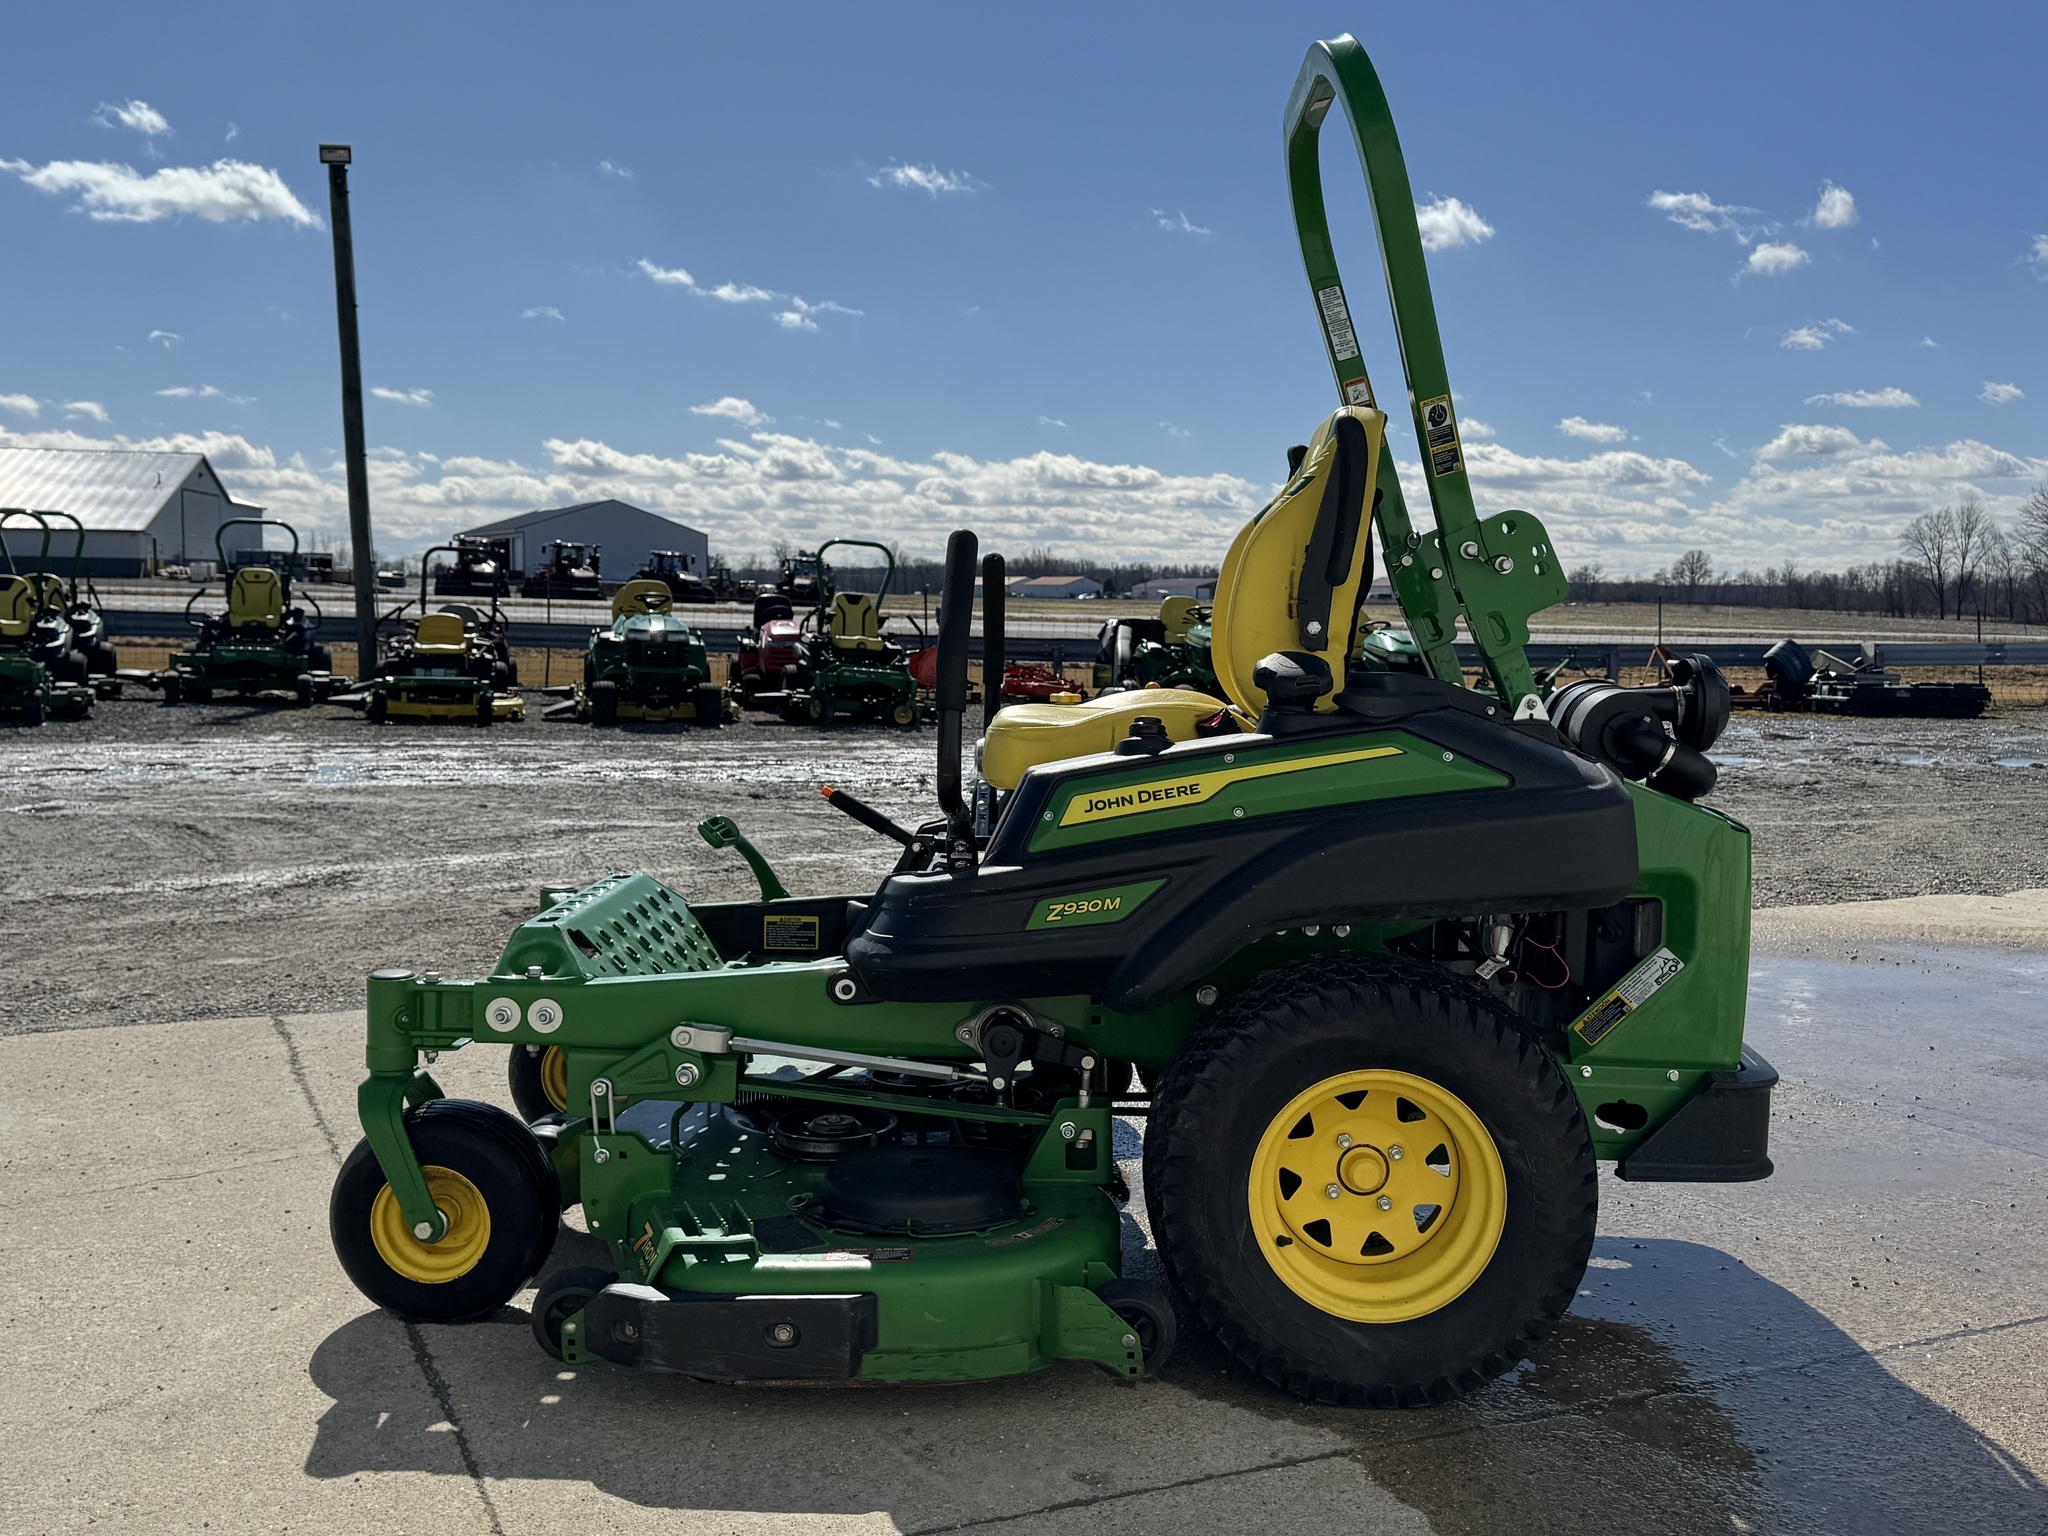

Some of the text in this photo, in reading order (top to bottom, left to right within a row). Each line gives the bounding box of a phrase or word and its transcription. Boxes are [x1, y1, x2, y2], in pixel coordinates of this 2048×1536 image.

[1084, 783, 1201, 813] JOHN DEERE
[1045, 896, 1122, 922] Z930M
